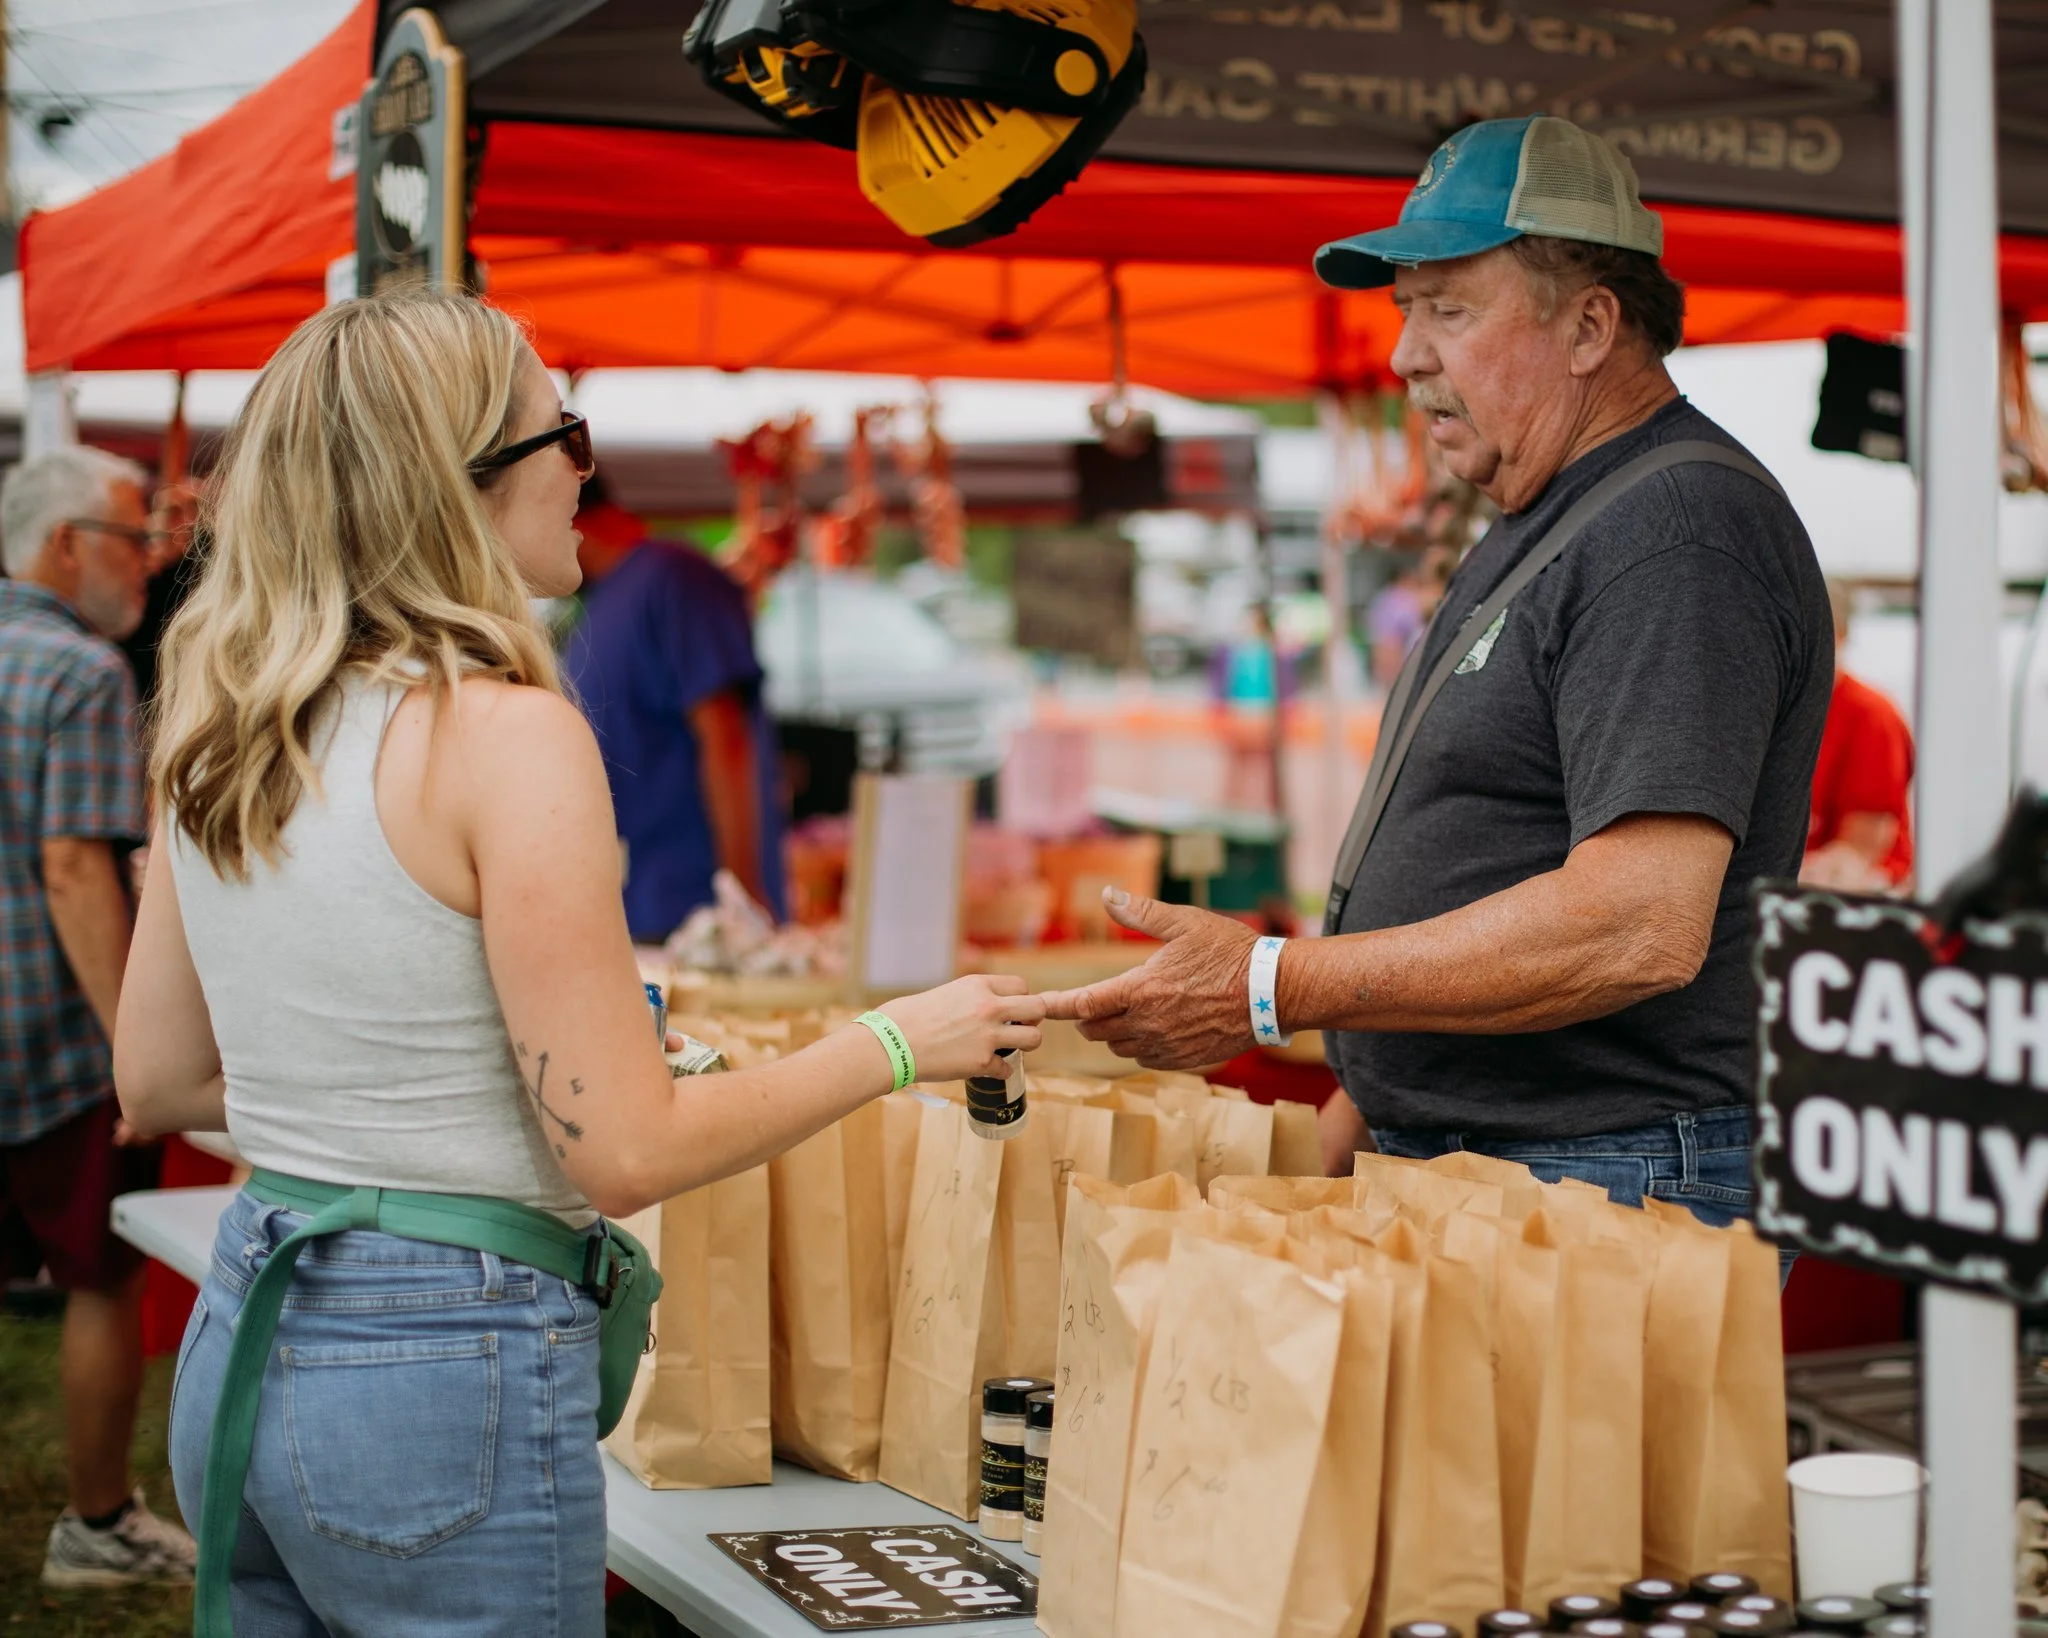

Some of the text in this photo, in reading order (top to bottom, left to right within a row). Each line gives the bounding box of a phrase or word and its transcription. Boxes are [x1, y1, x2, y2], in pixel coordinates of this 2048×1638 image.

[1788, 949, 2048, 1092] CASH
[1790, 1096, 2048, 1242] ONLY
[775, 1544, 921, 1610] ONLY
[871, 1538, 1022, 1606] CASH
